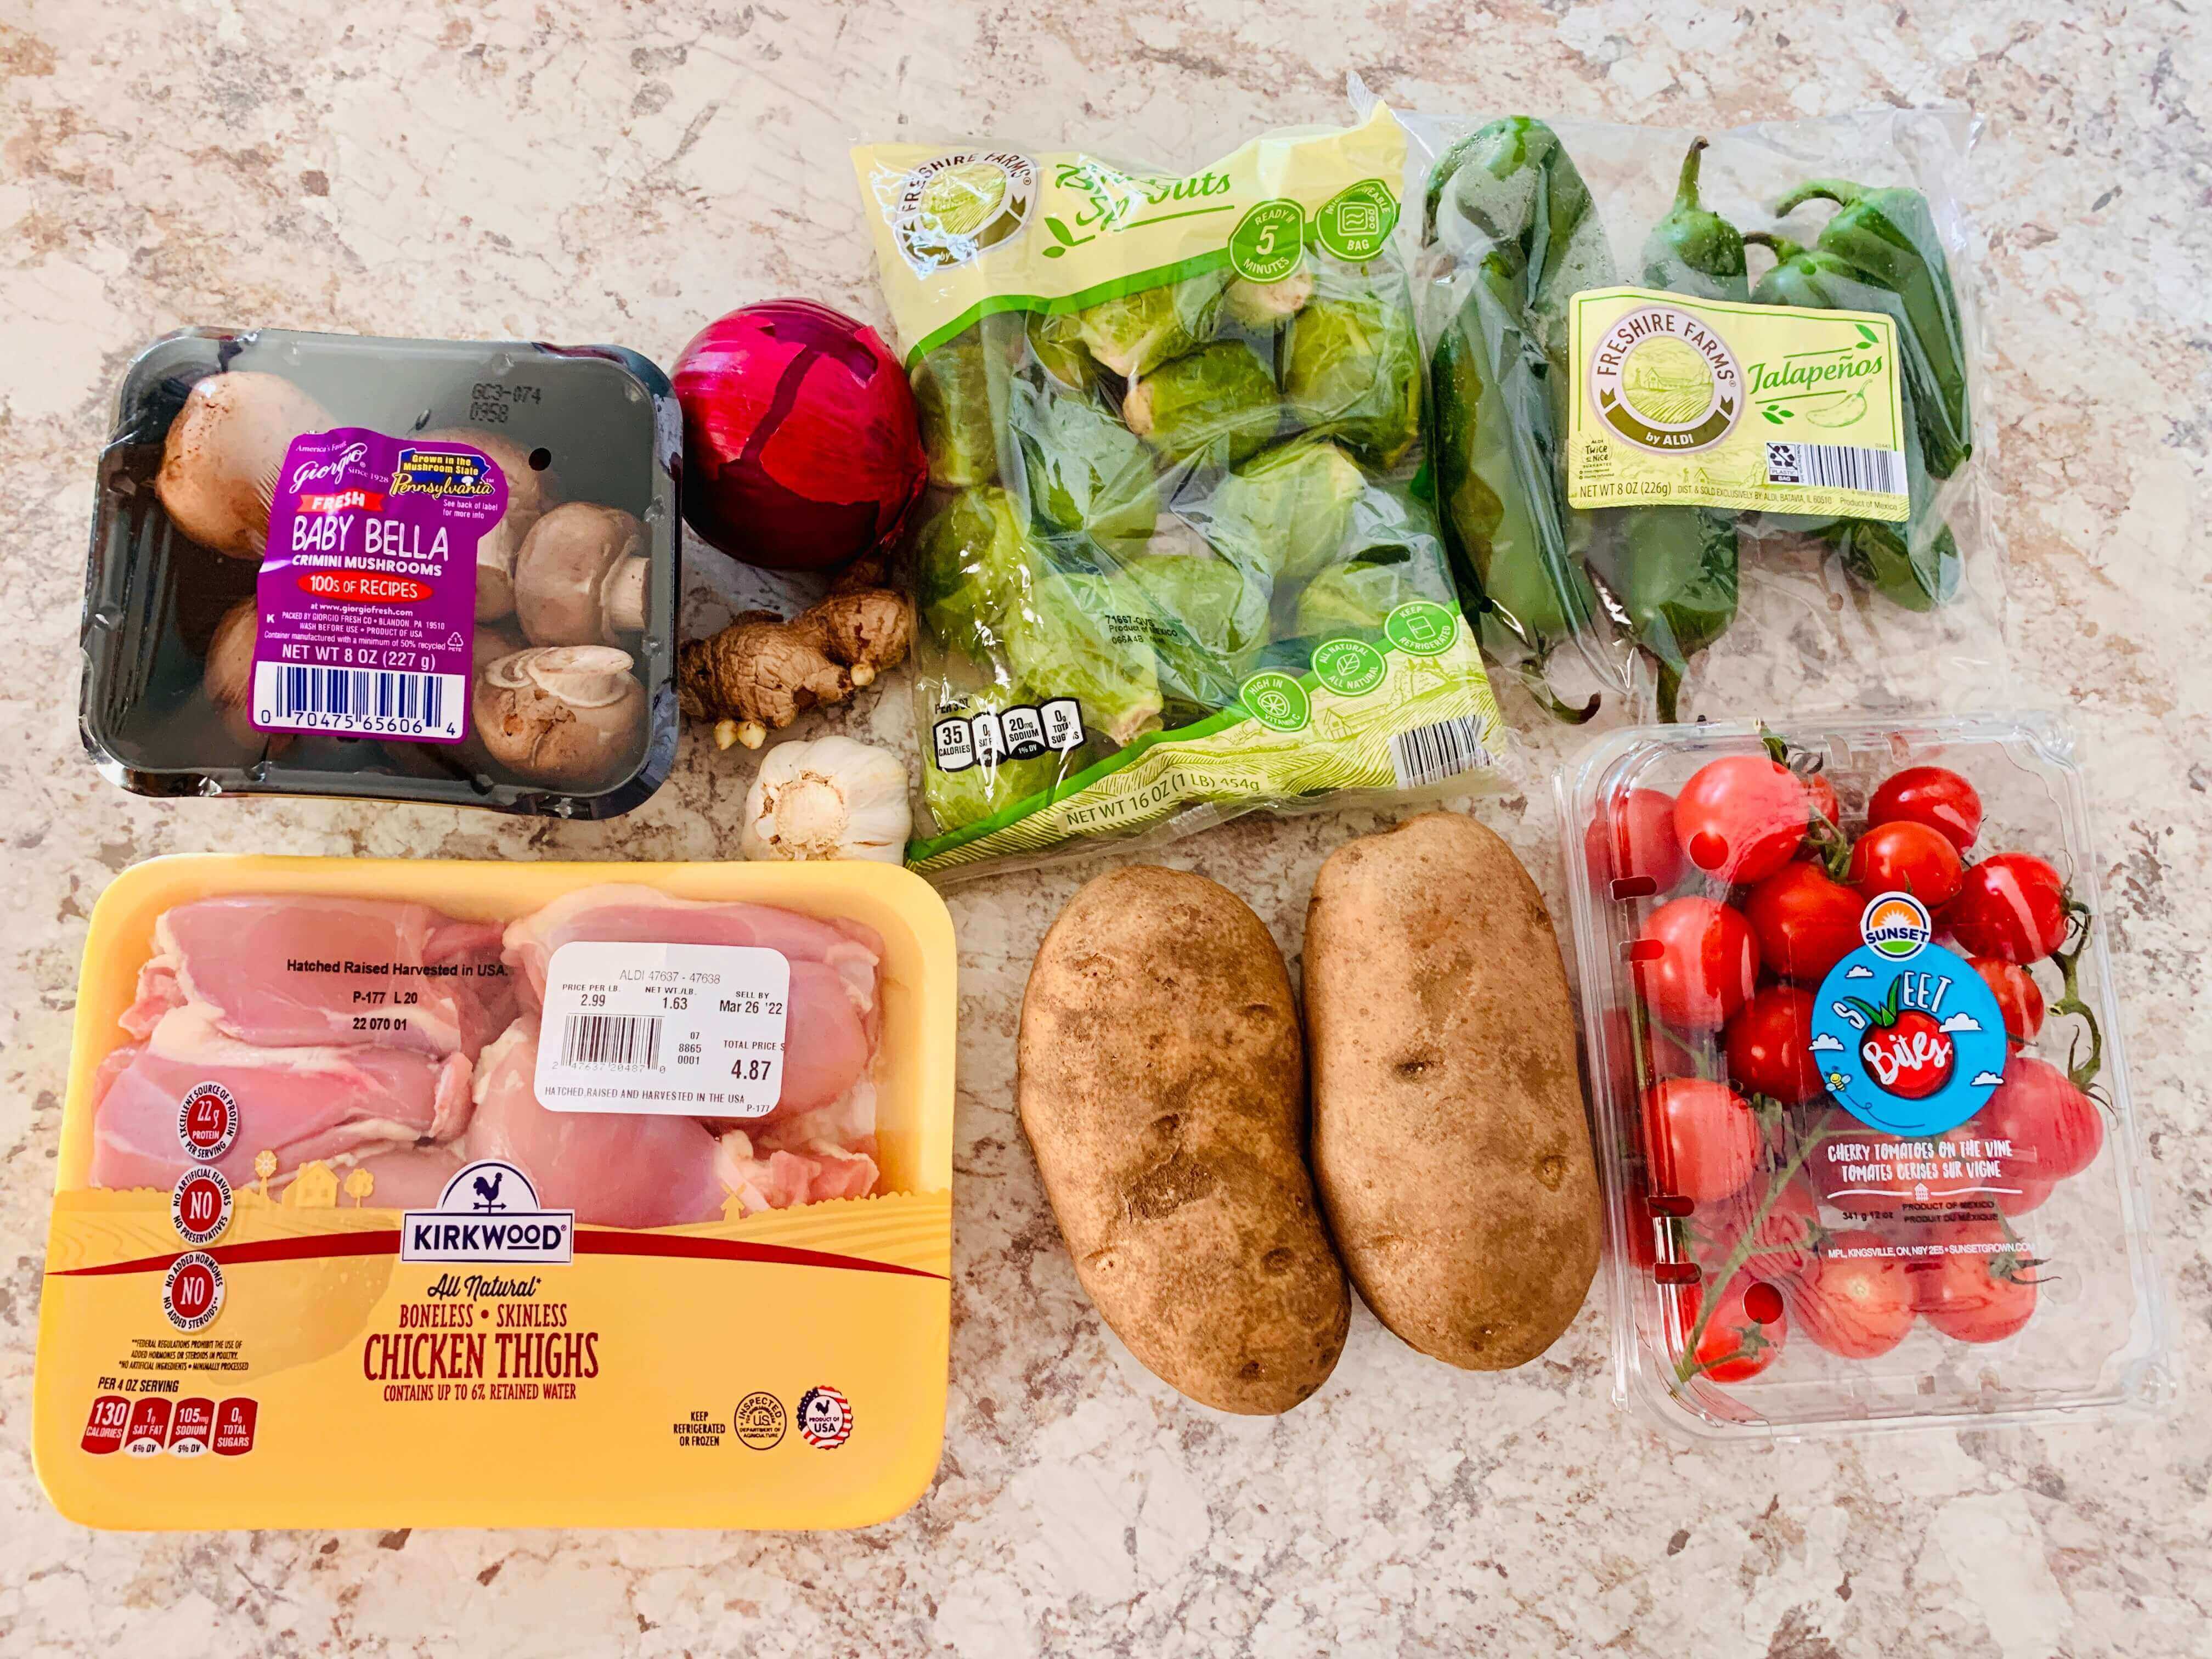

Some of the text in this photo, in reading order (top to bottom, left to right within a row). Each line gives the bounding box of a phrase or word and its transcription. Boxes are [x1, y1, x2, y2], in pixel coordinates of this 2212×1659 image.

[1255, 225, 1279, 255] 5
[1347, 239, 1370, 252] BAG
[1243, 257, 1290, 274] MINUTES
[1597, 313, 1734, 380] FRESHIRE FARMS
[1747, 354, 1882, 394] Jalapeños
[1645, 432, 1694, 445] by ALDI
[289, 442, 368, 494] Giorgio
[403, 463, 453, 473] Mushroom
[457, 457, 471, 466] the
[390, 472, 494, 499] Pennsylvania
[1580, 481, 1671, 498] NET WT OZ (226g)
[1678, 485, 1693, 494] DIST.
[1701, 486, 1715, 495] SOLD
[312, 492, 365, 511] FRESH
[483, 503, 498, 511] label
[1875, 501, 1898, 511] Mexico
[292, 515, 449, 561] BABY BELLA
[292, 555, 442, 577] CRIMINI MUSHROOMS
[343, 579, 417, 599] OF RECIPES
[319, 603, 413, 616] www.giorgiofresh.com
[1398, 606, 1423, 619] KEEP
[282, 611, 302, 619] PACKED
[312, 613, 339, 622] GIORGIO
[341, 615, 361, 624] FRESH
[426, 622, 445, 630] 19510
[318, 624, 343, 632] BEFORE
[366, 627, 397, 636] PRODUCT
[1109, 624, 1140, 633] Product
[291, 633, 335, 642] manufactured
[1398, 625, 1451, 650] REFRIGERATED
[1330, 644, 1368, 656] NATURAL
[283, 644, 436, 671] NET WT 8 OZ (227 g)
[1328, 665, 1379, 689] ALL NATURAL
[1249, 678, 1283, 696] HIGH IN
[1055, 710, 1066, 722] 0g
[1264, 714, 1296, 726] VITAMIN
[942, 725, 963, 745] 35
[1009, 729, 1039, 742] SODIUM
[939, 745, 970, 757] CALORIES
[1066, 781, 1170, 826] NET WT 16 OZ
[1866, 928, 1929, 944] SUNSET
[287, 959, 474, 976] Hatched Raised Harvested in
[619, 969, 720, 984] ALDI 47637 47638
[353, 991, 418, 1005] P-177 20
[580, 994, 606, 1007] 2.99
[663, 997, 687, 1010] 1.63
[720, 1000, 759, 1014] Mar 26
[353, 1018, 408, 1031] 22 070 01
[679, 1043, 702, 1053] 8865
[724, 1040, 776, 1051] TOTAL PRICE
[1862, 1031, 1951, 1085] Bites
[731, 1059, 771, 1080] 4.87
[220, 1090, 230, 1101] OF
[620, 1089, 746, 1104] AND HARVESTED THE USA
[193, 1130, 219, 1139] PROTEIN
[198, 1141, 226, 1158] SERVING
[1827, 1139, 2013, 1162] CHERRY TOMATOES ON THE VINE
[1842, 1160, 2002, 1182] TOMATES CERISES SUR VIGNE
[179, 1168, 232, 1206] ARTIFICIAL FLAVORS
[189, 1191, 212, 1219] NO
[1903, 1201, 1957, 1211] PRODUCT OF
[1843, 1212, 1858, 1220] 341
[180, 1216, 228, 1243] PRESERVATIVES
[414, 1224, 561, 1250] KIRKWOOD
[1848, 1245, 1944, 1257] KINGSVILLE, N9Y 2E5
[180, 1277, 205, 1305] NO
[427, 1273, 460, 1301] All
[399, 1304, 567, 1328] BONELESS SKINLESS
[364, 1332, 599, 1380] CHICKEN THIGHS
[98, 1376, 179, 1392] PER 4 OZ SERVING
[384, 1384, 576, 1402] CONTAINS UP TO 6% RETAINED WATER
[94, 1401, 127, 1425] 130
[738, 1397, 782, 1419] INSPECTED
[691, 1411, 708, 1422] KEEP
[86, 1426, 122, 1438] CALORIES
[132, 1425, 163, 1435] SAT FAT
[176, 1425, 206, 1435] SODIUM
[224, 1425, 246, 1435] TOTAL
[673, 1423, 725, 1434] REFRIGERATED
[814, 1423, 836, 1433] USA
[146, 1444, 156, 1453] DV
[217, 1437, 249, 1447] SUGARS
[680, 1436, 719, 1447] OR FROZEN
